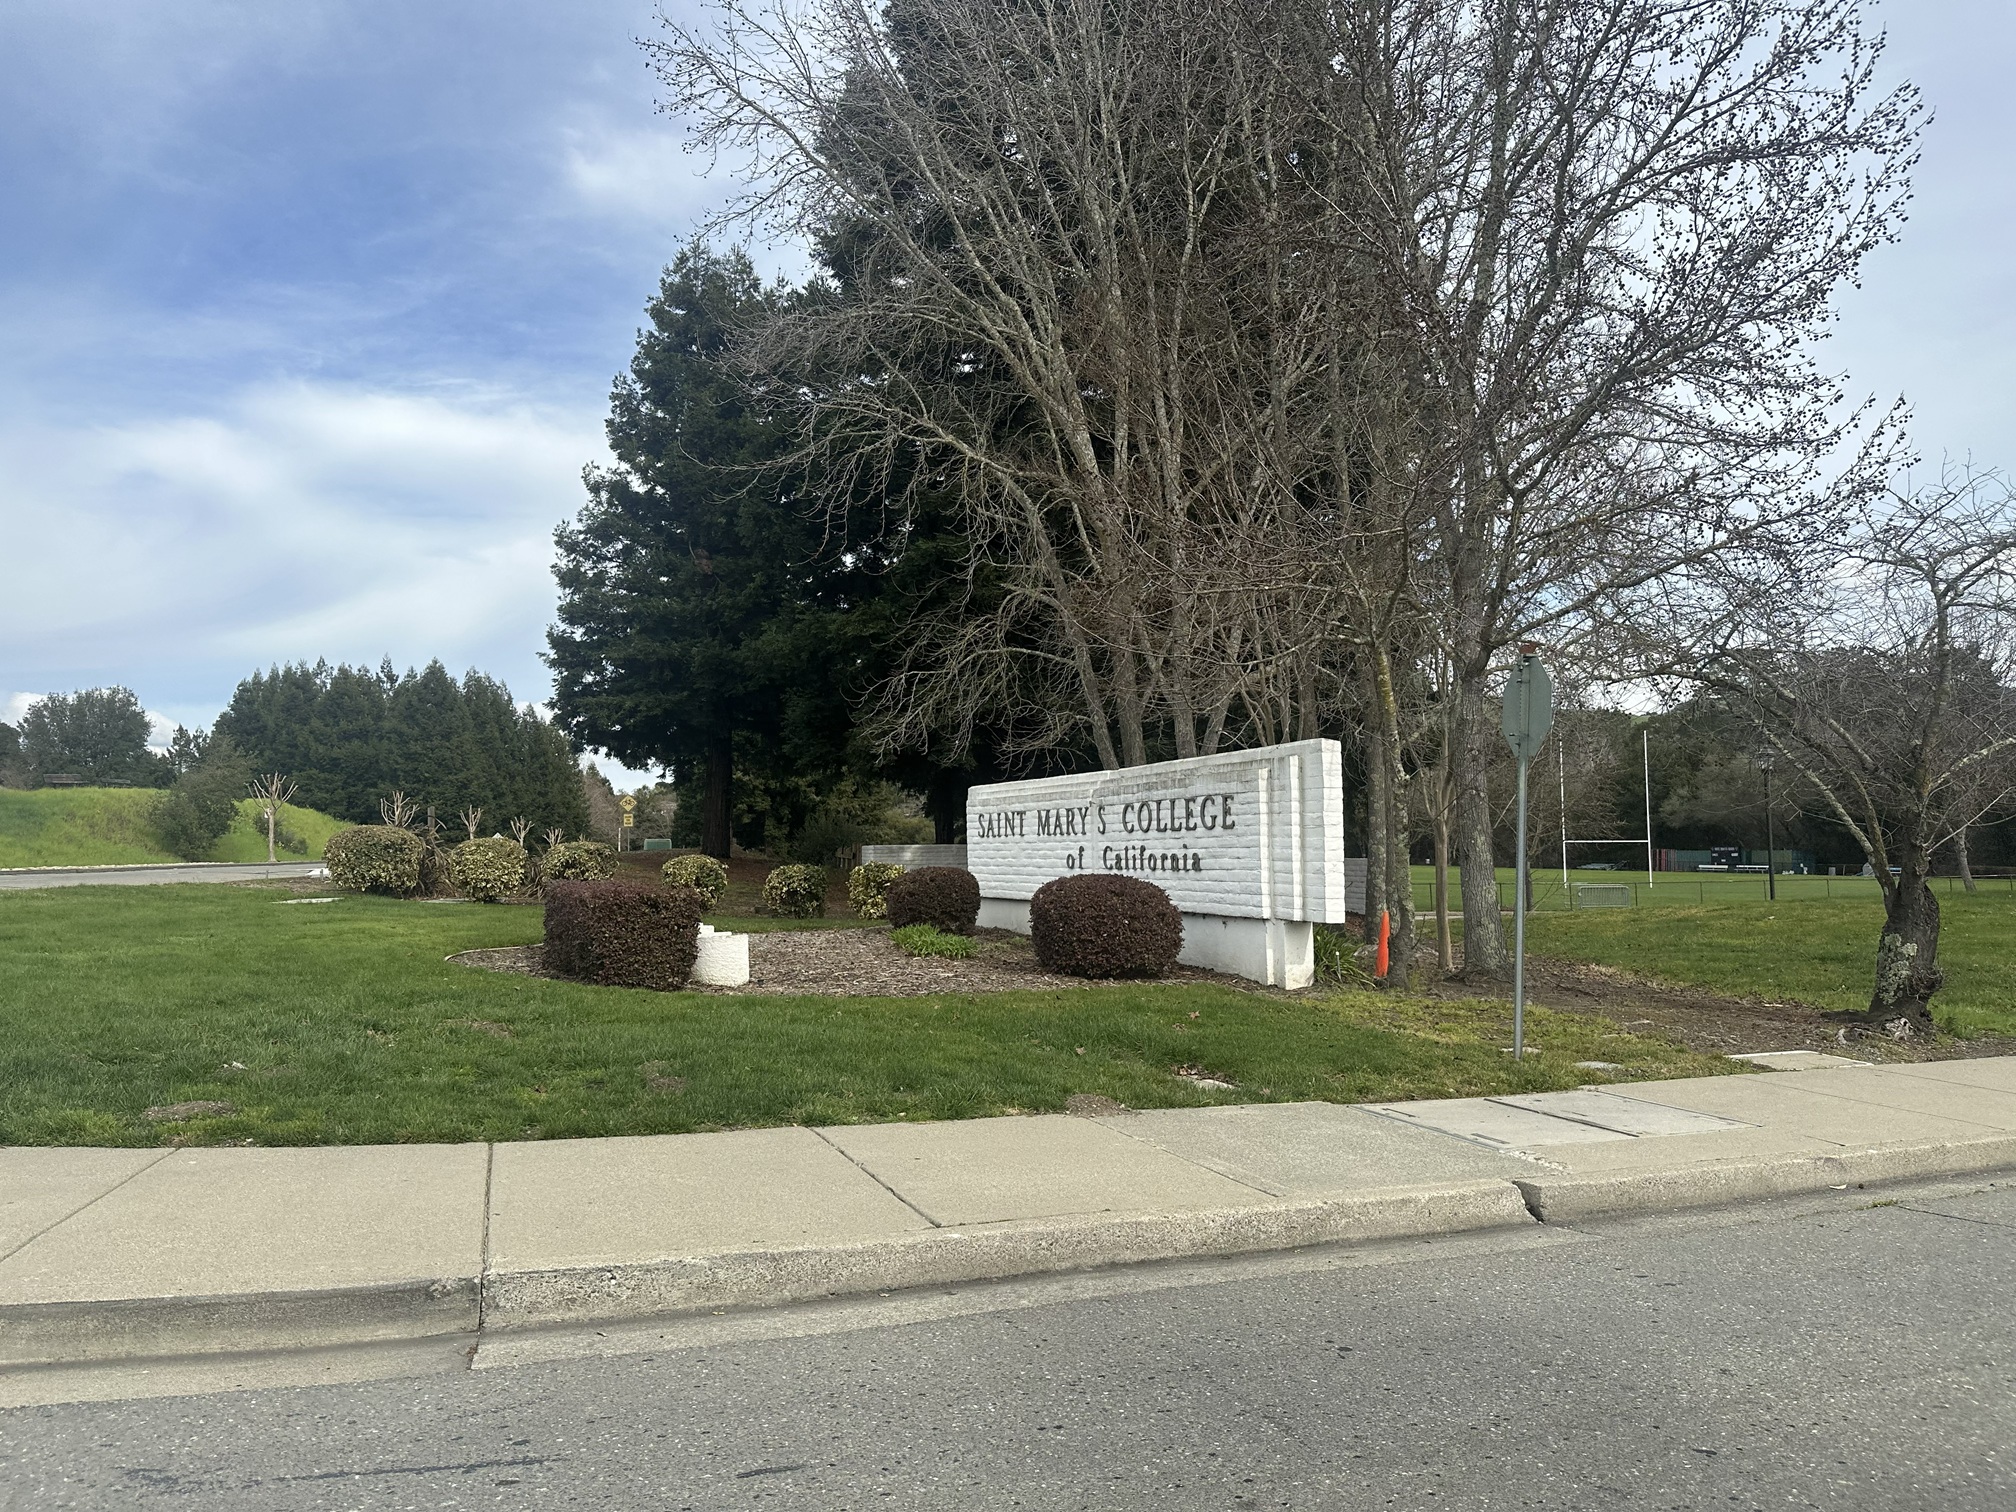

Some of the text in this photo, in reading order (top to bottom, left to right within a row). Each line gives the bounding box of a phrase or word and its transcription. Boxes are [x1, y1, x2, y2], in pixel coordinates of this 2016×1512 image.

[978, 811, 1026, 838] SAINT
[1121, 794, 1236, 833] COLLEGE
[1066, 844, 1202, 872] of California
